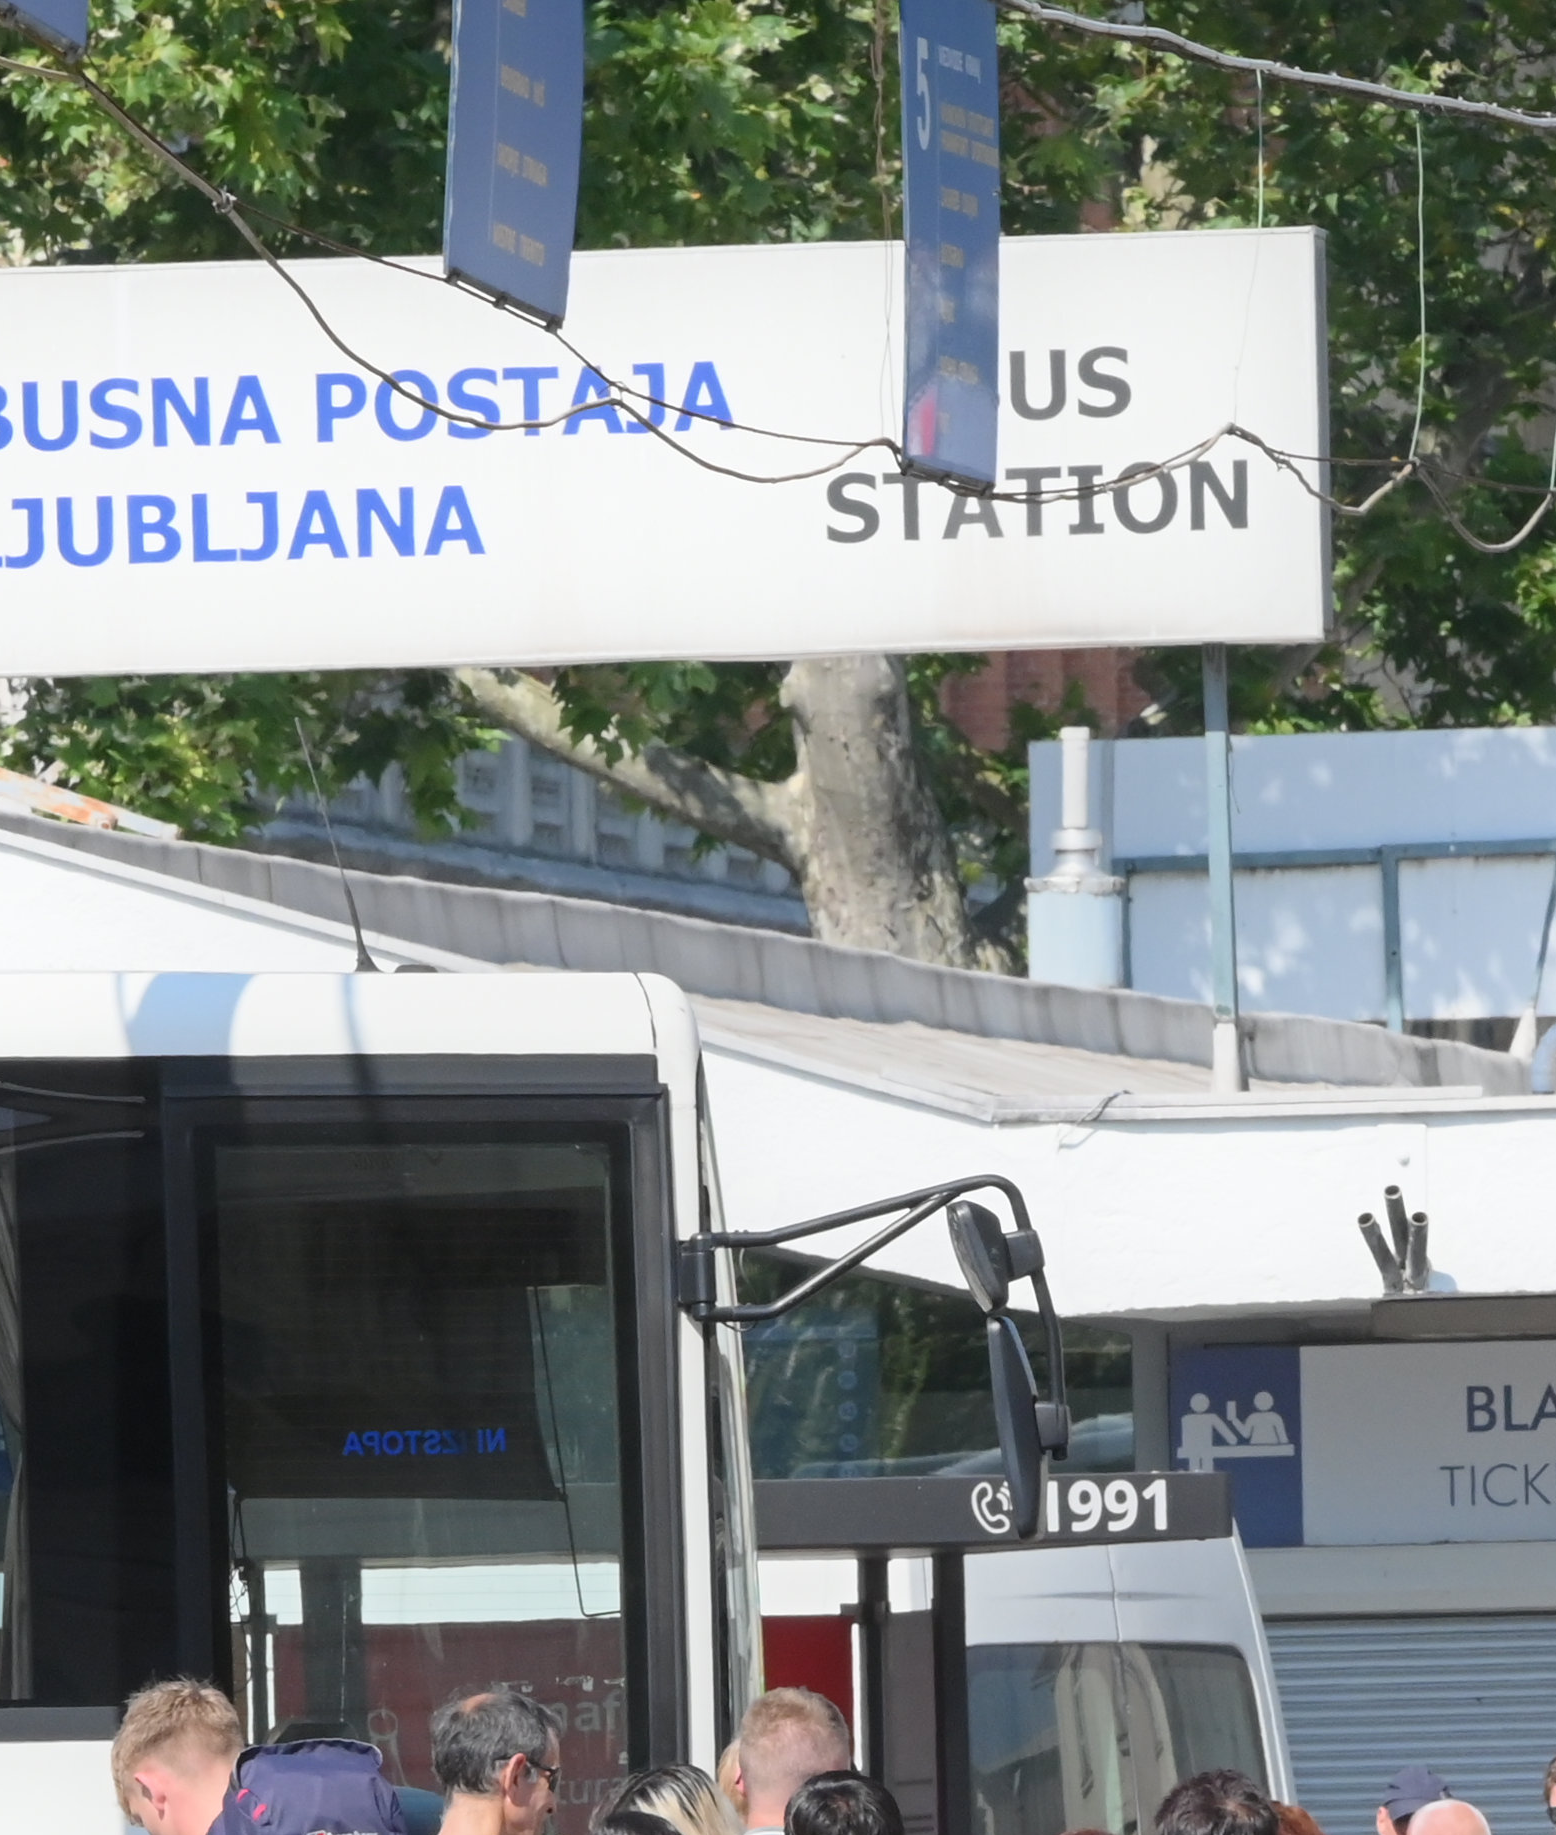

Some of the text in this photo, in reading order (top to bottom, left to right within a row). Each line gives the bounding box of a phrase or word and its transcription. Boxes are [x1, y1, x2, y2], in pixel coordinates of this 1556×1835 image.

[316, 360, 739, 443] POSTAJA
[1009, 345, 1133, 420] US
[826, 459, 1249, 544] STATION
[1046, 1479, 1168, 1533] 1991
